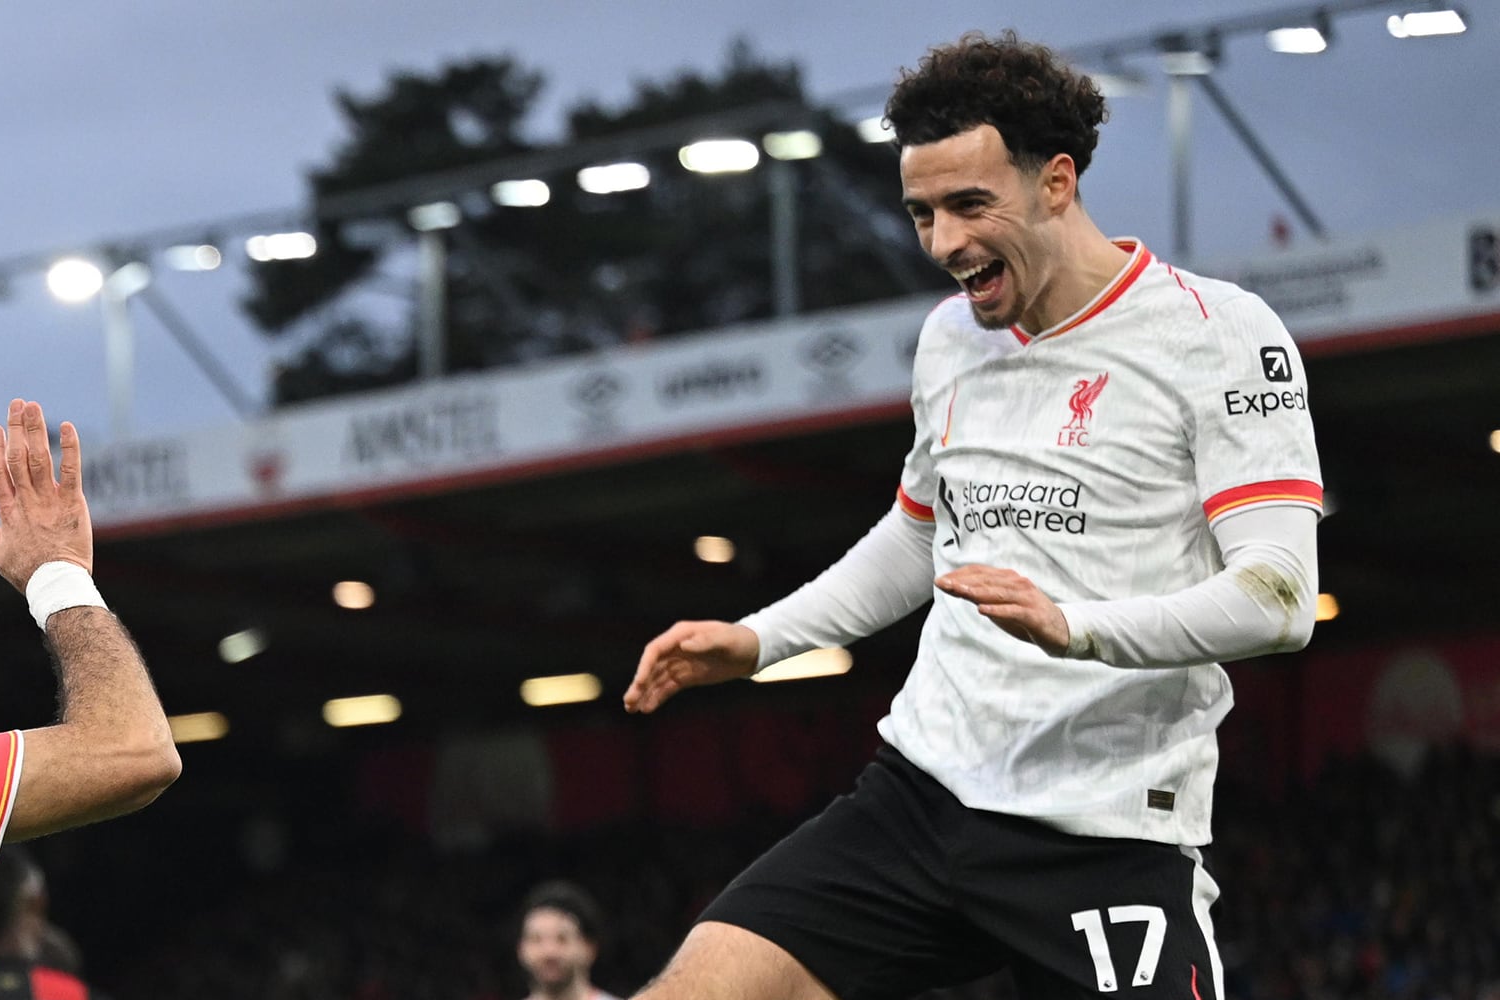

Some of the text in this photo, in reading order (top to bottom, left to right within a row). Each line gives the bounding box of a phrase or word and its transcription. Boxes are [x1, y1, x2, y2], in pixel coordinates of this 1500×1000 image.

[962, 481, 1081, 509] standard
[963, 503, 1087, 535] chartered
[1070, 904, 1168, 993] 17
